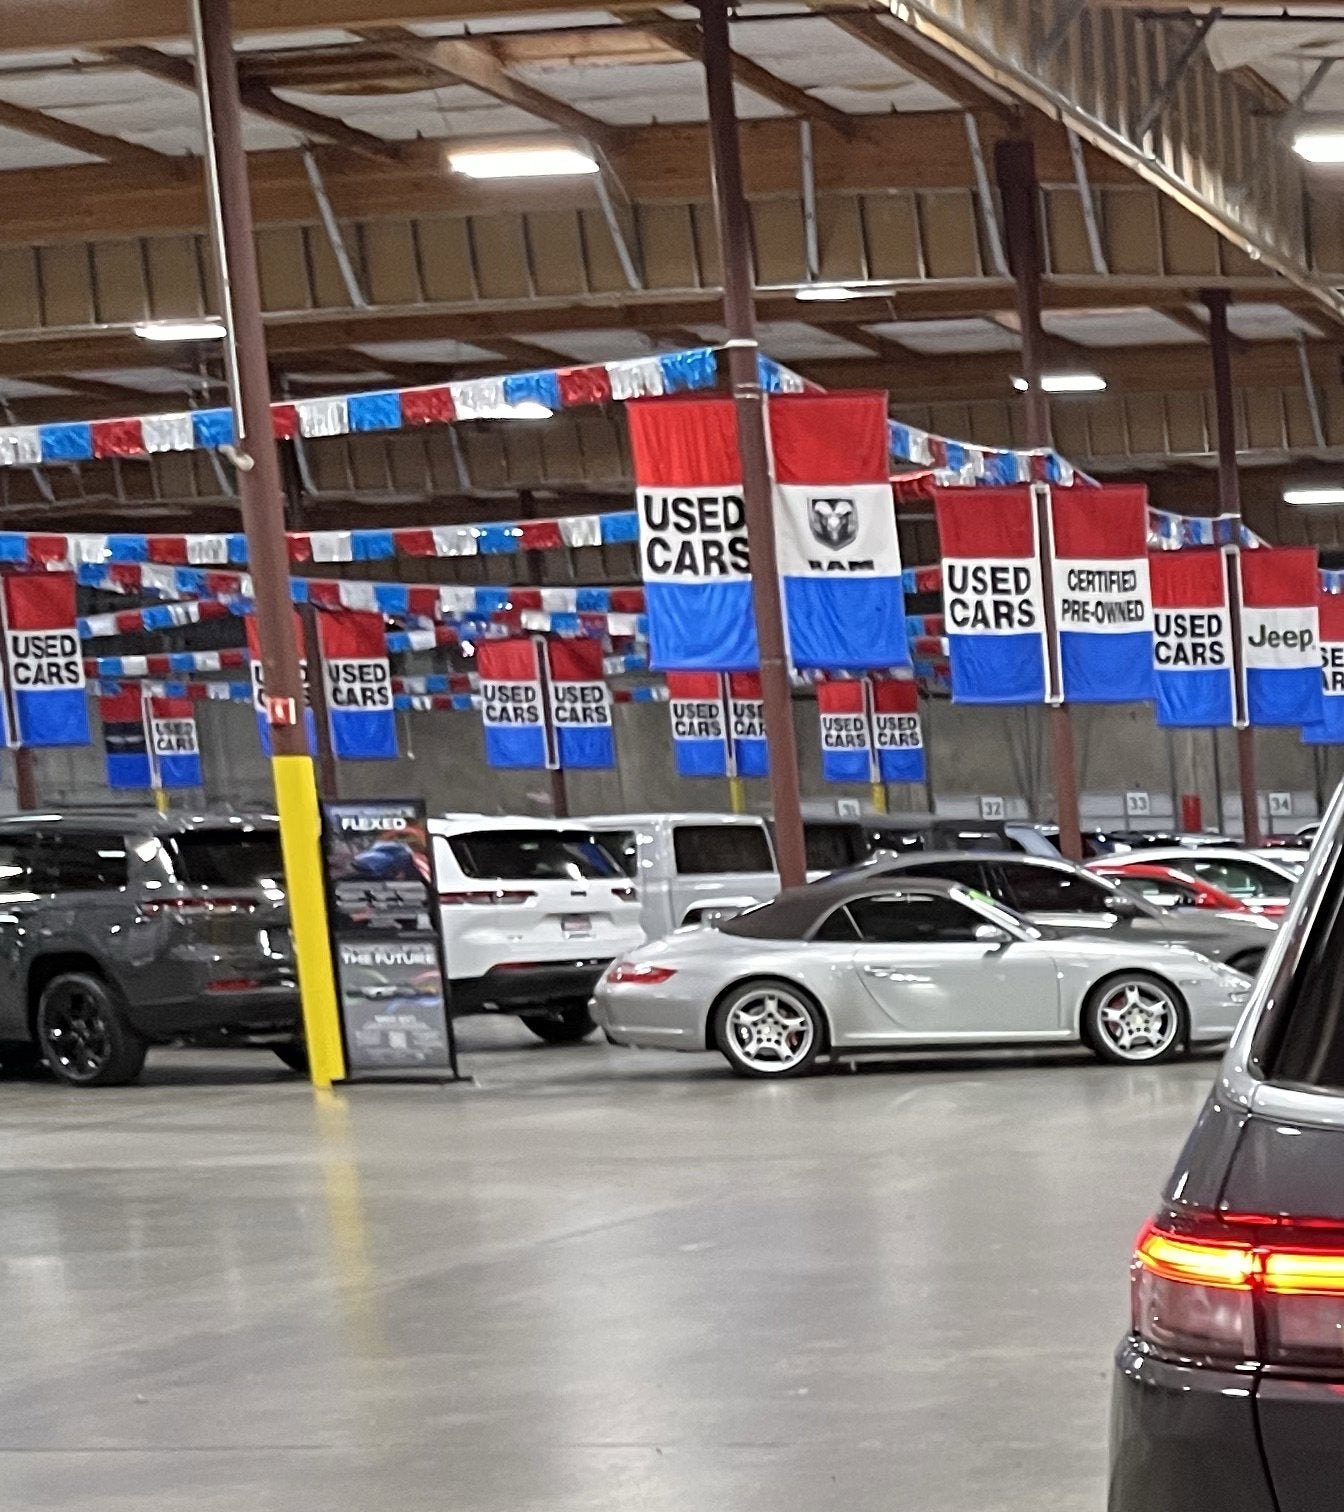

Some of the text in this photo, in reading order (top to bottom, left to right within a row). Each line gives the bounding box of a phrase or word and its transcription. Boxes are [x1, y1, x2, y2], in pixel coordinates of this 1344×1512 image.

[644, 495, 746, 533] USED
[646, 536, 750, 576] CARS
[948, 565, 1032, 595] USED
[1067, 569, 1137, 593] CERTIFIED
[950, 598, 1036, 629] CARS
[1062, 599, 1145, 624] PRE-OWNED
[1154, 613, 1222, 638] USED
[12, 635, 77, 659] USED
[1248, 624, 1313, 652] Jeep
[1154, 640, 1226, 666] CARS
[14, 661, 80, 685] CARS
[328, 664, 387, 683] USED
[332, 686, 389, 706] CARS
[483, 685, 536, 703] USED
[554, 686, 604, 703] USED
[486, 705, 539, 722] CARS
[555, 705, 607, 722] CARS
[673, 703, 720, 719] USED
[675, 721, 721, 736] CARS
[823, 718, 863, 732] USED
[876, 717, 917, 731] USED
[824, 733, 866, 747] CARS
[877, 732, 920, 746] CARS
[984, 801, 1001, 816] 32
[1130, 795, 1147, 811] 33
[1273, 795, 1289, 811] 34
